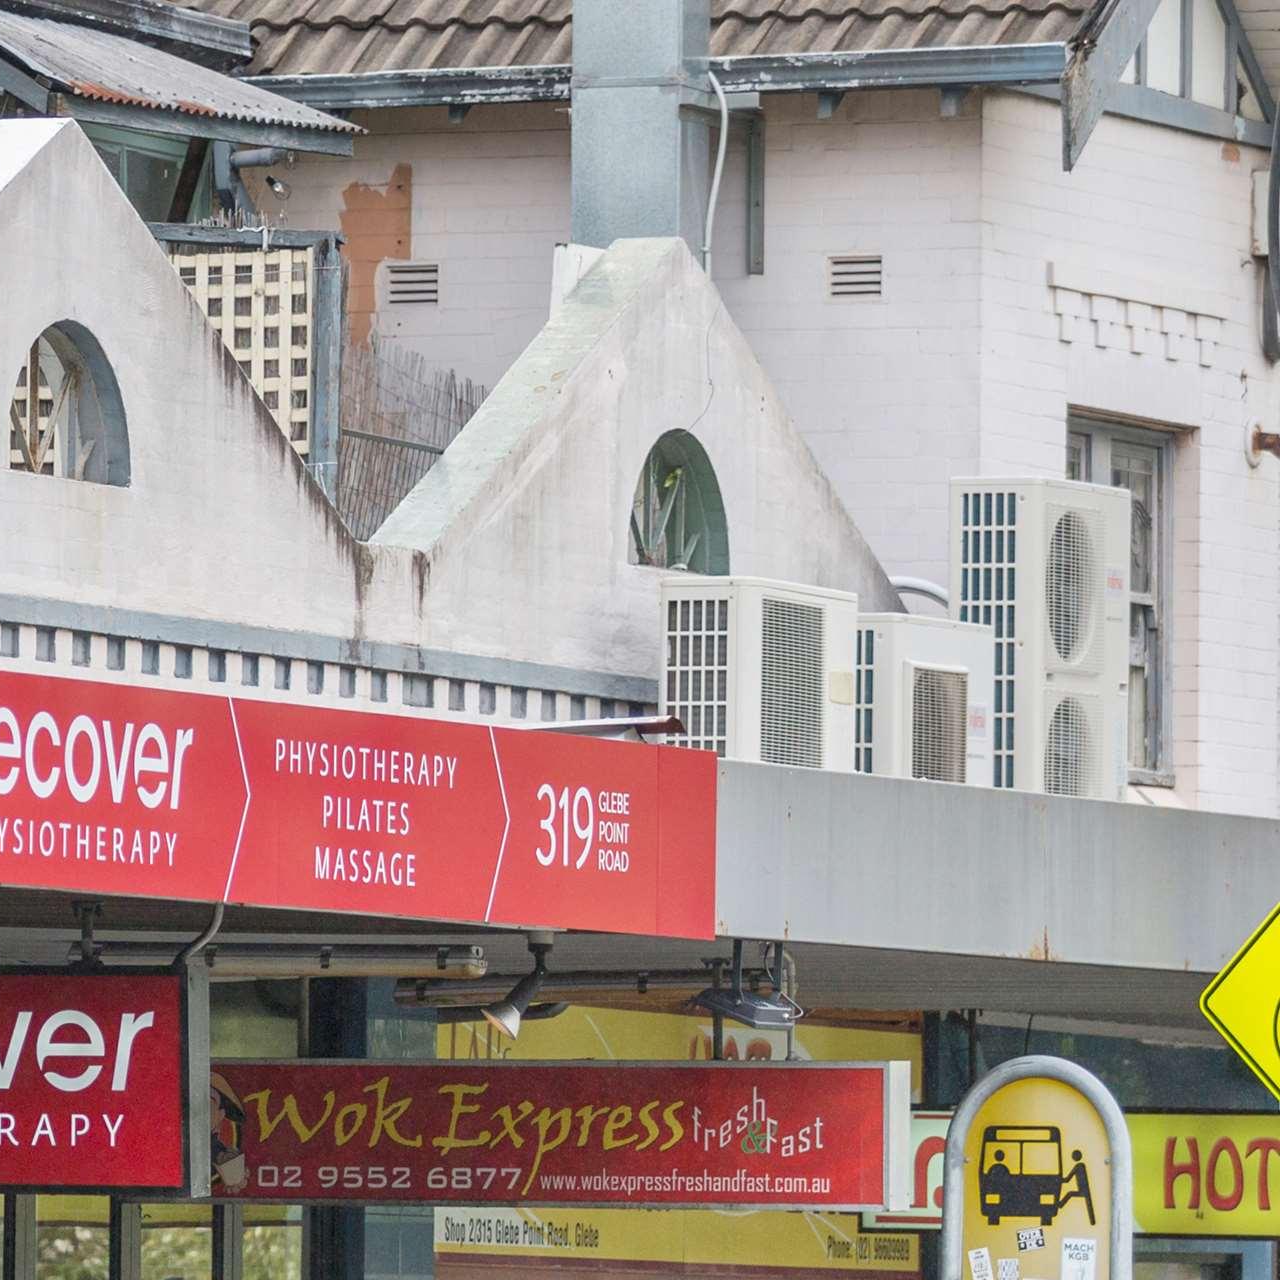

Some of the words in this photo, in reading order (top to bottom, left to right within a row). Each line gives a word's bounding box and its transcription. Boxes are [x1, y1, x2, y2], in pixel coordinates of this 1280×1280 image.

[274, 737, 458, 790] PHYSIOTHERAPY
[322, 794, 411, 837] PILATES
[598, 790, 631, 816] GLEBE
[534, 782, 595, 873] 319
[598, 820, 631, 844] POINT
[314, 845, 417, 888] MASSAGE
[598, 847, 631, 873] ROAD
[691, 1085, 766, 1152] fresh
[242, 1077, 425, 1150] Wok
[432, 1081, 686, 1197] Express
[256, 1165, 302, 1189] 02
[317, 1166, 413, 1190] 9552
[426, 1167, 522, 1192] 6877
[540, 1168, 831, 1195] www.wokexpressfreshandfast.com.au
[1163, 1135, 1280, 1211] HOT
[444, 1216, 466, 1248] Shop
[469, 1218, 492, 1246] 2/315
[495, 1219, 520, 1245] Glebe
[522, 1220, 544, 1247] Point
[575, 1222, 600, 1248] Glebe
[1064, 1242, 1094, 1252] MACH
[1068, 1252, 1090, 1262] KGB
